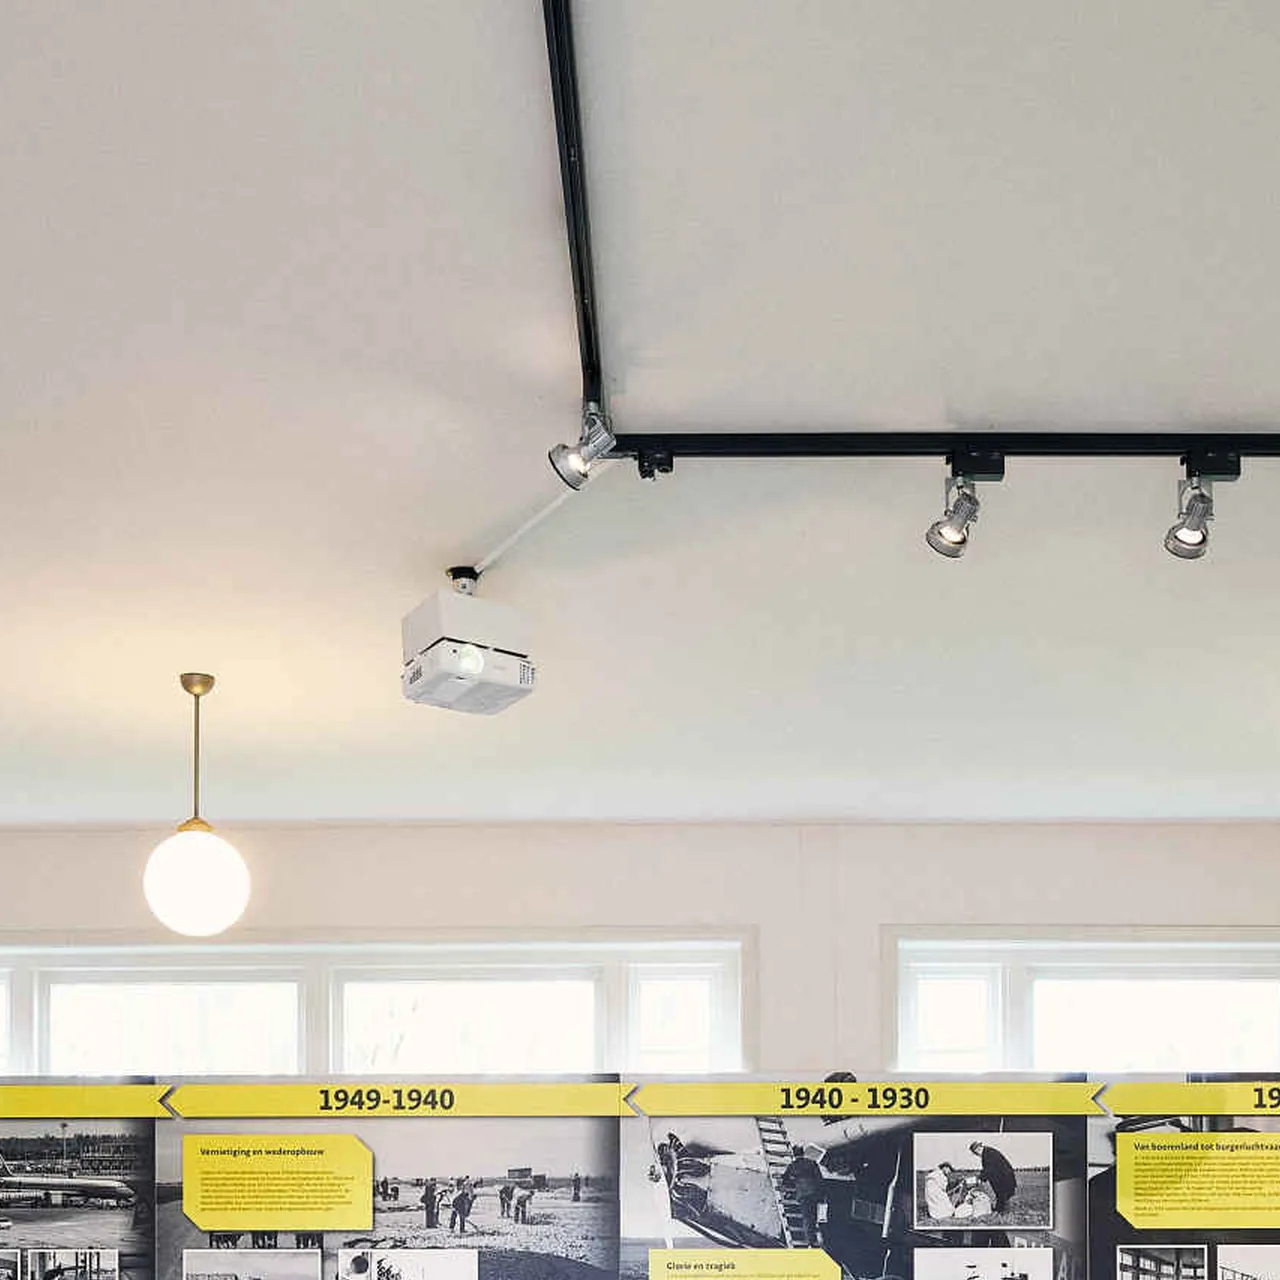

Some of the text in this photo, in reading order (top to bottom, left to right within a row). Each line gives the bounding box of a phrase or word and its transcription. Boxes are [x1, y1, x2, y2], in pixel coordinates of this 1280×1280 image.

[318, 1088, 455, 1111] 1949-1940
[780, 1087, 844, 1110] 1940
[866, 1087, 929, 1110] 1930
